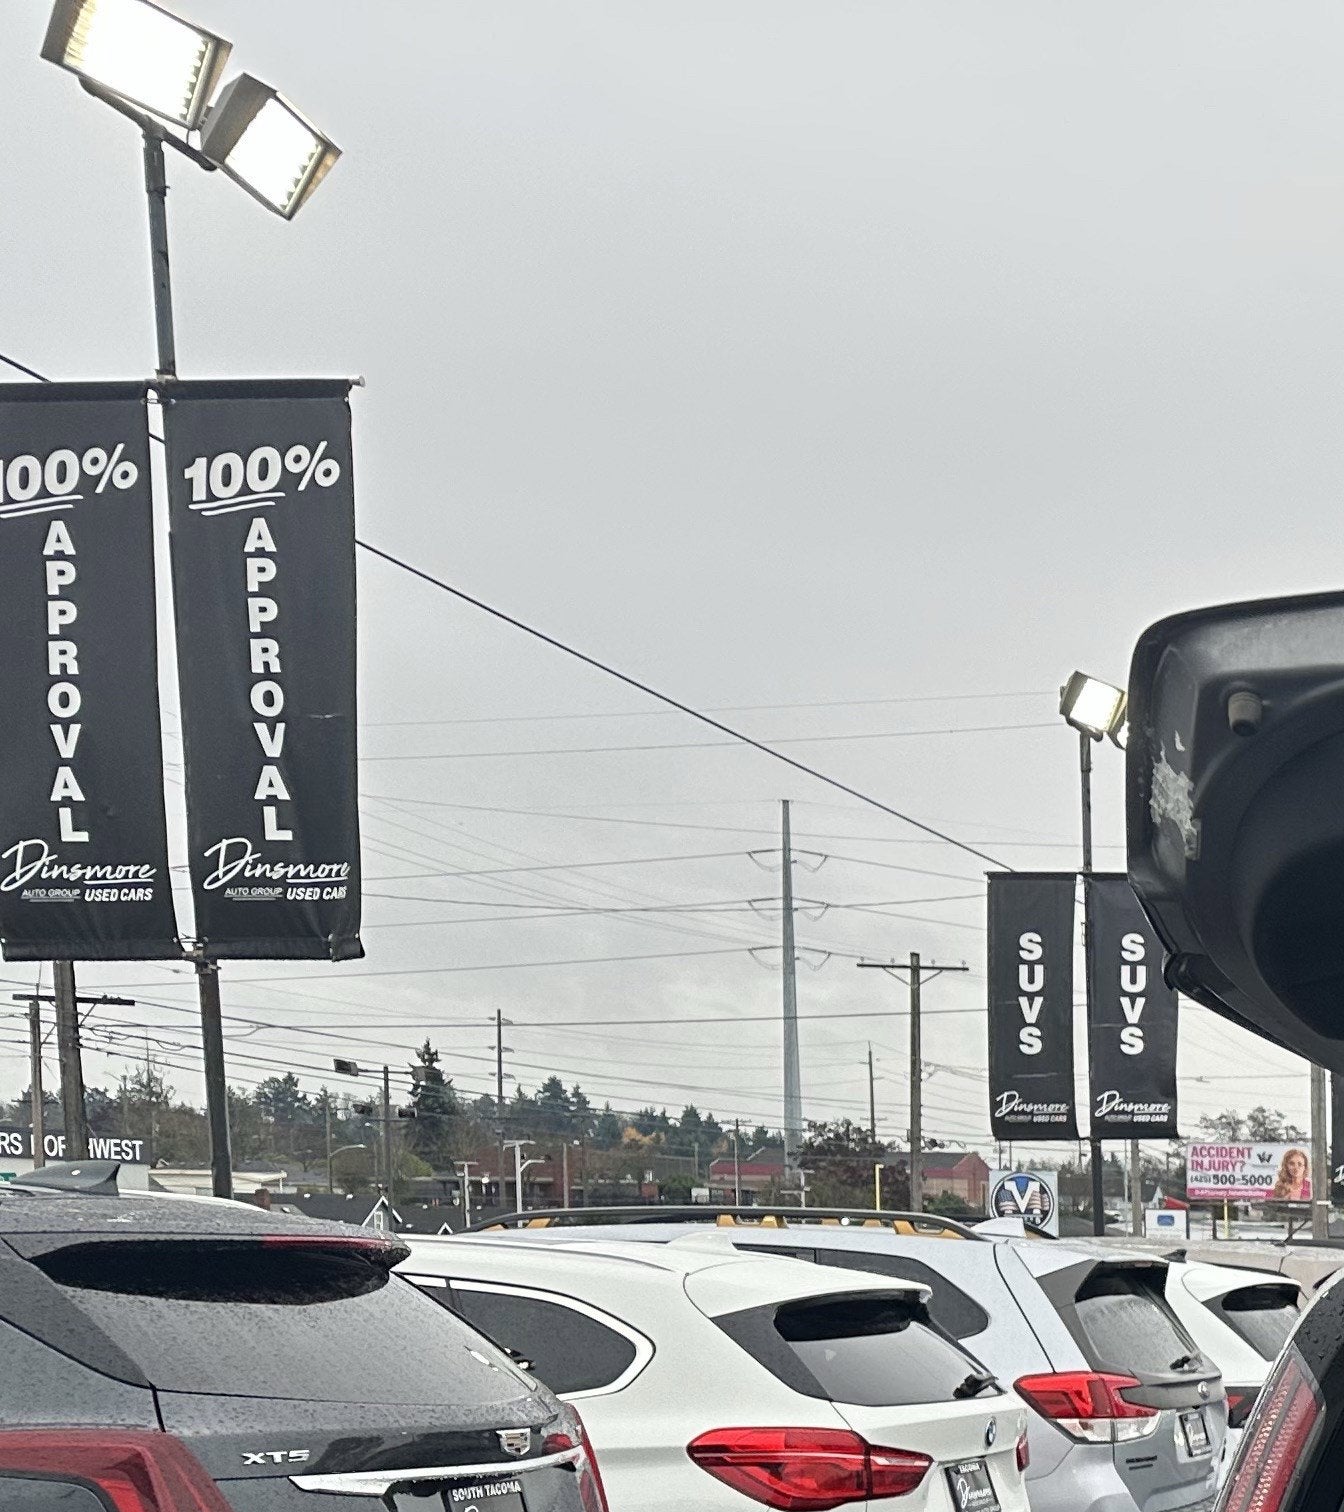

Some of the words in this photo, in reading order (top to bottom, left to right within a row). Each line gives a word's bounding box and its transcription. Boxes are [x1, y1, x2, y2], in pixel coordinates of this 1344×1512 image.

[0, 443, 138, 503] 00%
[184, 441, 340, 502] 100%
[43, 520, 89, 842] APPROVAL
[244, 517, 292, 841] APPROVAL
[1, 839, 157, 891] Dinsmore
[203, 838, 350, 889] Dinsmore
[22, 889, 46, 897] AUTO
[48, 888, 80, 897] GROUP
[85, 888, 118, 901] USED
[120, 888, 153, 901] CARS
[225, 887, 249, 895] AUTO
[251, 887, 283, 895] GROUP
[287, 887, 320, 900] USED
[1018, 932, 1045, 1056] SUVS
[1120, 932, 1147, 1056] SUVS
[995, 1090, 1070, 1118] Dinsmore
[1095, 1090, 1171, 1118] Dinsmore
[31, 1134, 143, 1161] ORHWEST
[1191, 1146, 1253, 1159] ACCIDENT
[1191, 1160, 1246, 1172] INJURY?
[452, 1485, 483, 1501] SOUTH
[484, 1480, 521, 1496] TACOMA
